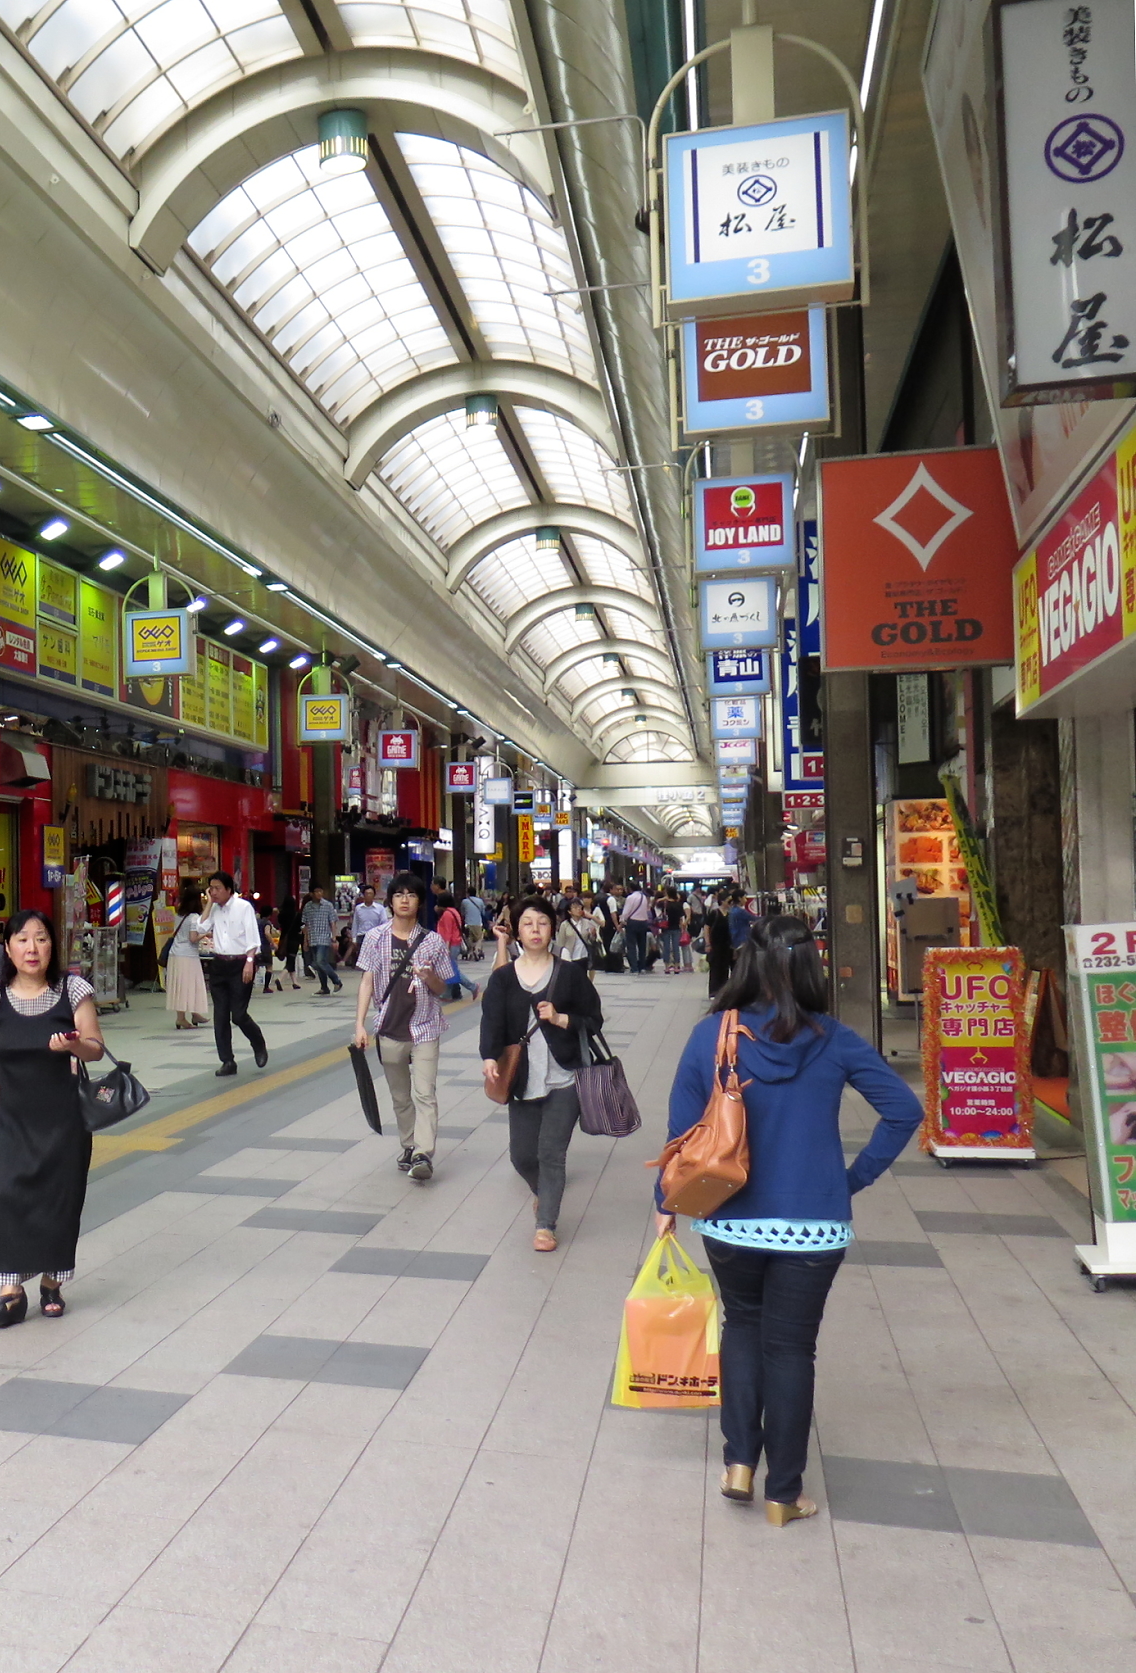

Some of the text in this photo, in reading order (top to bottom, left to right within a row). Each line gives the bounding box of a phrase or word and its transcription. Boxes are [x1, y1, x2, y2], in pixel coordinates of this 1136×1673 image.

[722, 157, 790, 176] 美装きもの
[719, 203, 796, 237] 松屋
[746, 258, 771, 285] 3
[1050, 207, 1130, 369] 松屋
[704, 336, 743, 351] THE
[703, 344, 802, 373] GOLD
[745, 400, 764, 420] 3
[707, 524, 782, 546] JOY LAND
[737, 550, 751, 564] 3
[1038, 520, 1120, 668] VEGAGIO
[894, 598, 959, 619] THE
[138, 624, 175, 640] GEO
[733, 632, 744, 645] 3
[870, 618, 984, 647] GOLD
[152, 662, 161, 672] 3
[716, 658, 760, 677] 青山
[735, 682, 743, 692] 3
[722, 719, 750, 727] コクミン
[697, 790, 706, 802] 2
[940, 974, 1013, 1001] UFO
[940, 1001, 1013, 1015] キャッチャー
[941, 1017, 1015, 1037] 専門店
